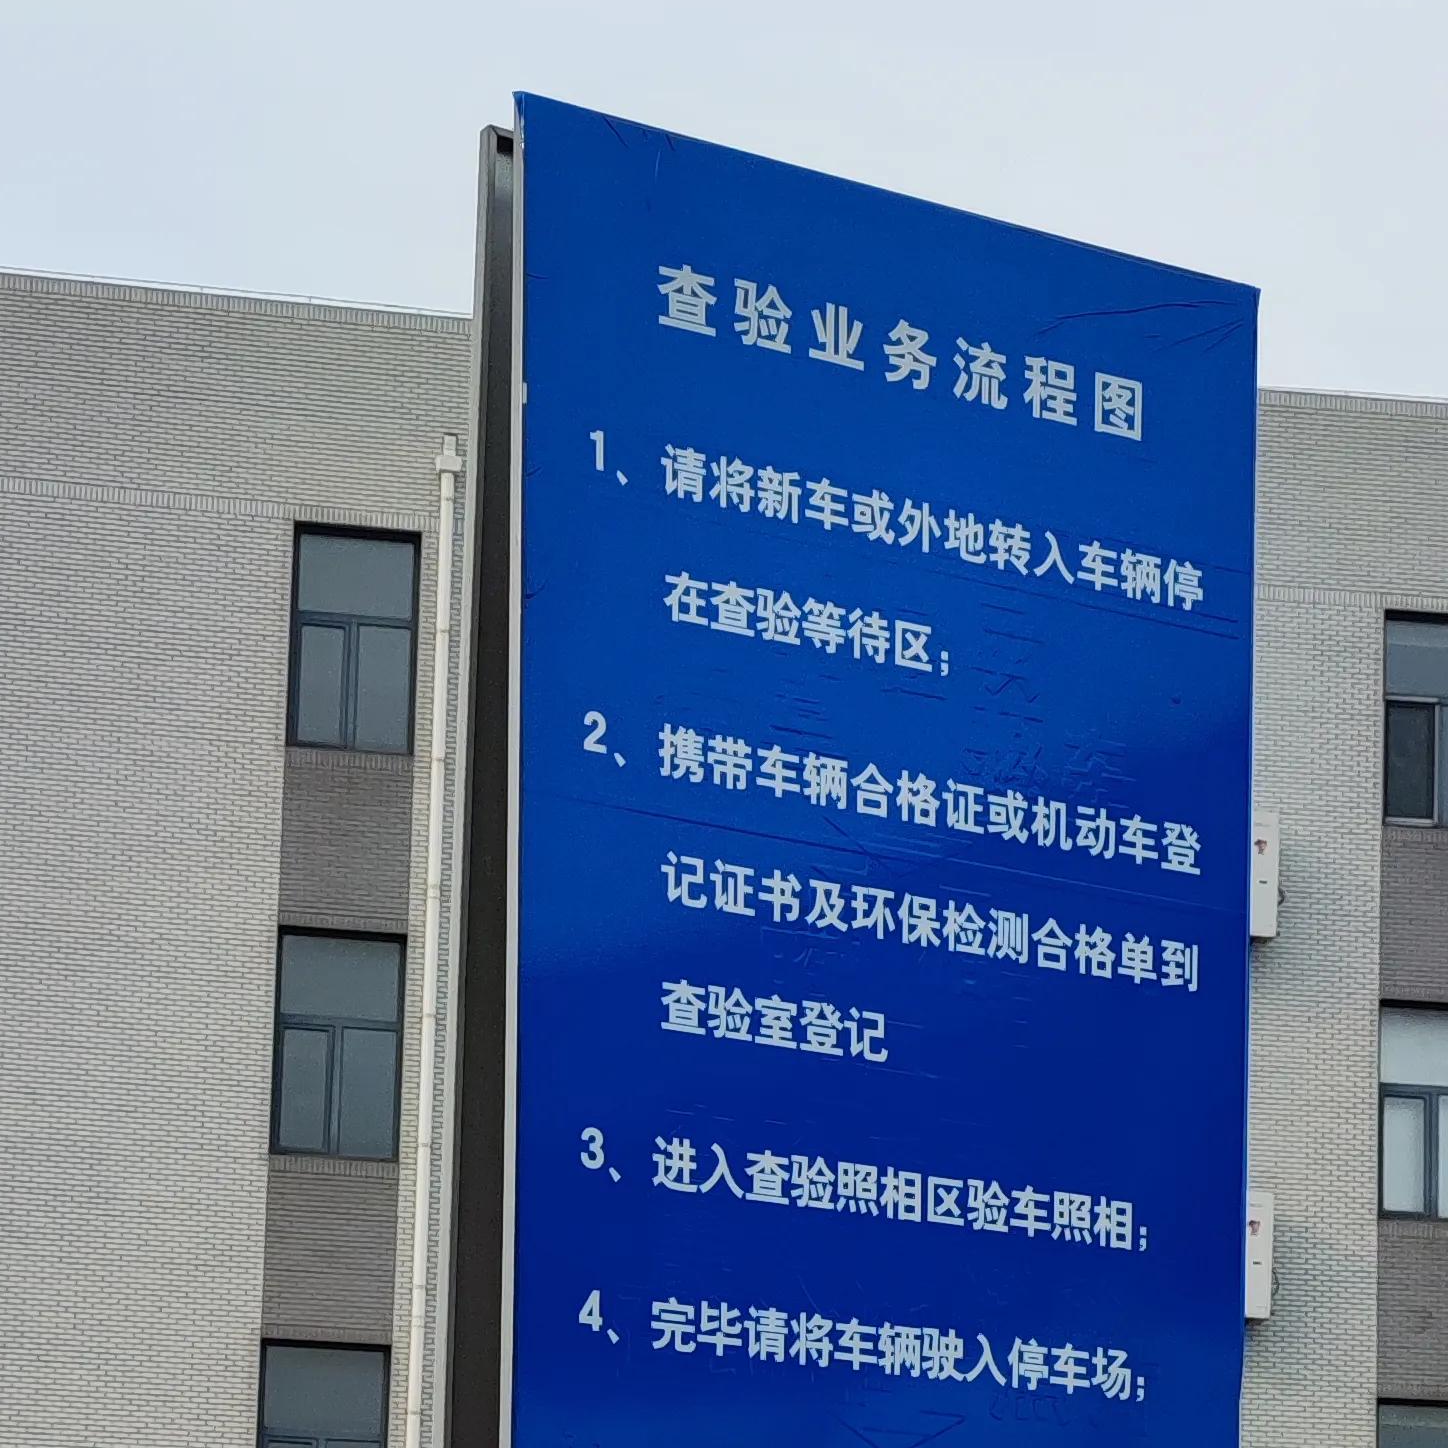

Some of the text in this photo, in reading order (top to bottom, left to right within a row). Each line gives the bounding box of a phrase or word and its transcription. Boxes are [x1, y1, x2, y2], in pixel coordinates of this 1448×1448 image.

[657, 264, 1144, 441] 查验业务流程图
[661, 851, 1200, 992] 记证书及环保检测合格单到
[660, 979, 889, 1063] 查验室登记
